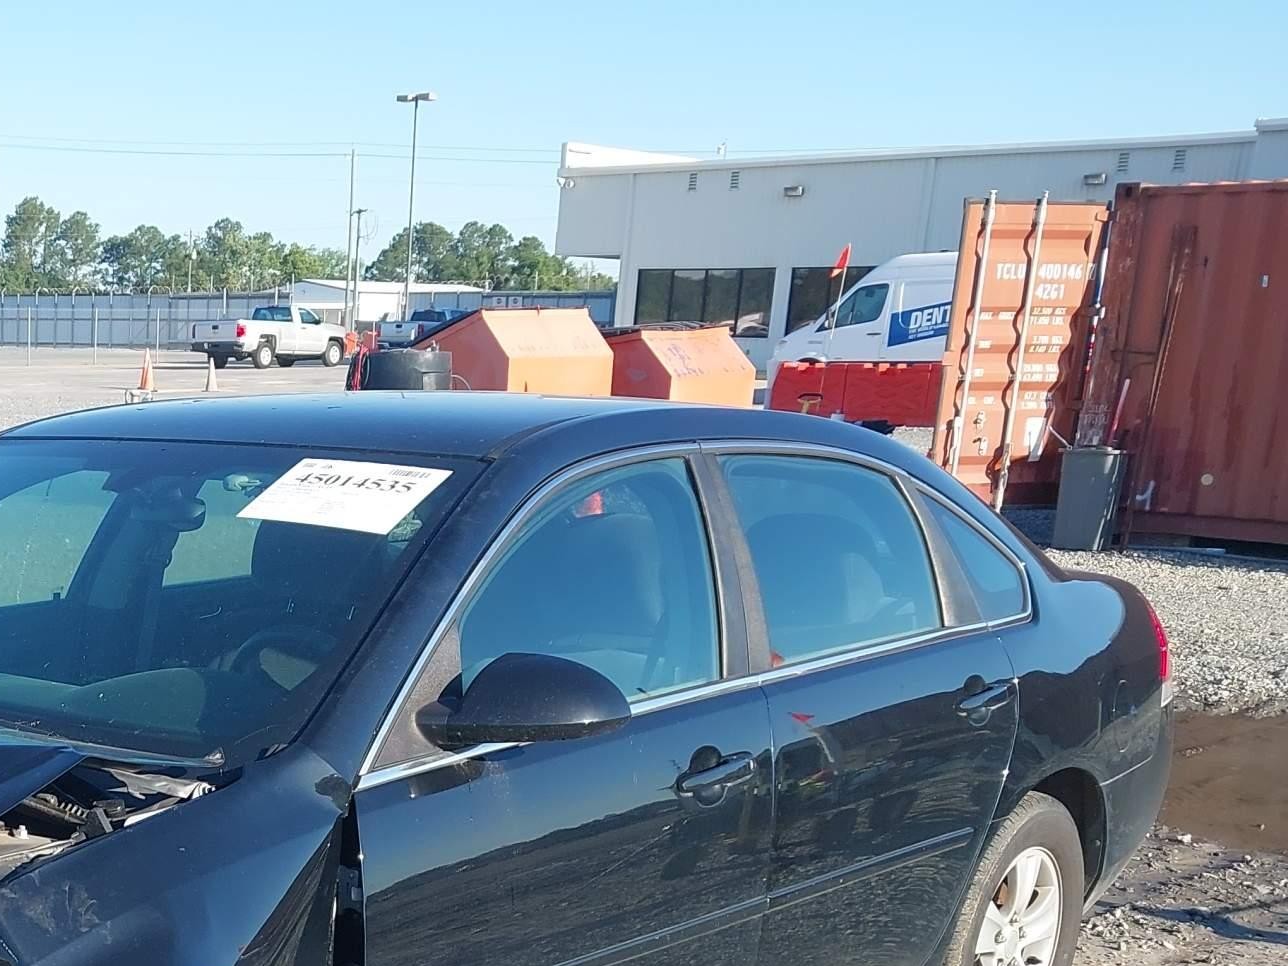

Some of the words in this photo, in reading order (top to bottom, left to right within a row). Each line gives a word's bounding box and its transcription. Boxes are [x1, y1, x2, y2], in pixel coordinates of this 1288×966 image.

[996, 263, 1027, 280] TCLU
[1038, 263, 1083, 280] 400146
[909, 305, 952, 329] DENT
[296, 472, 417, 494] 45014535
